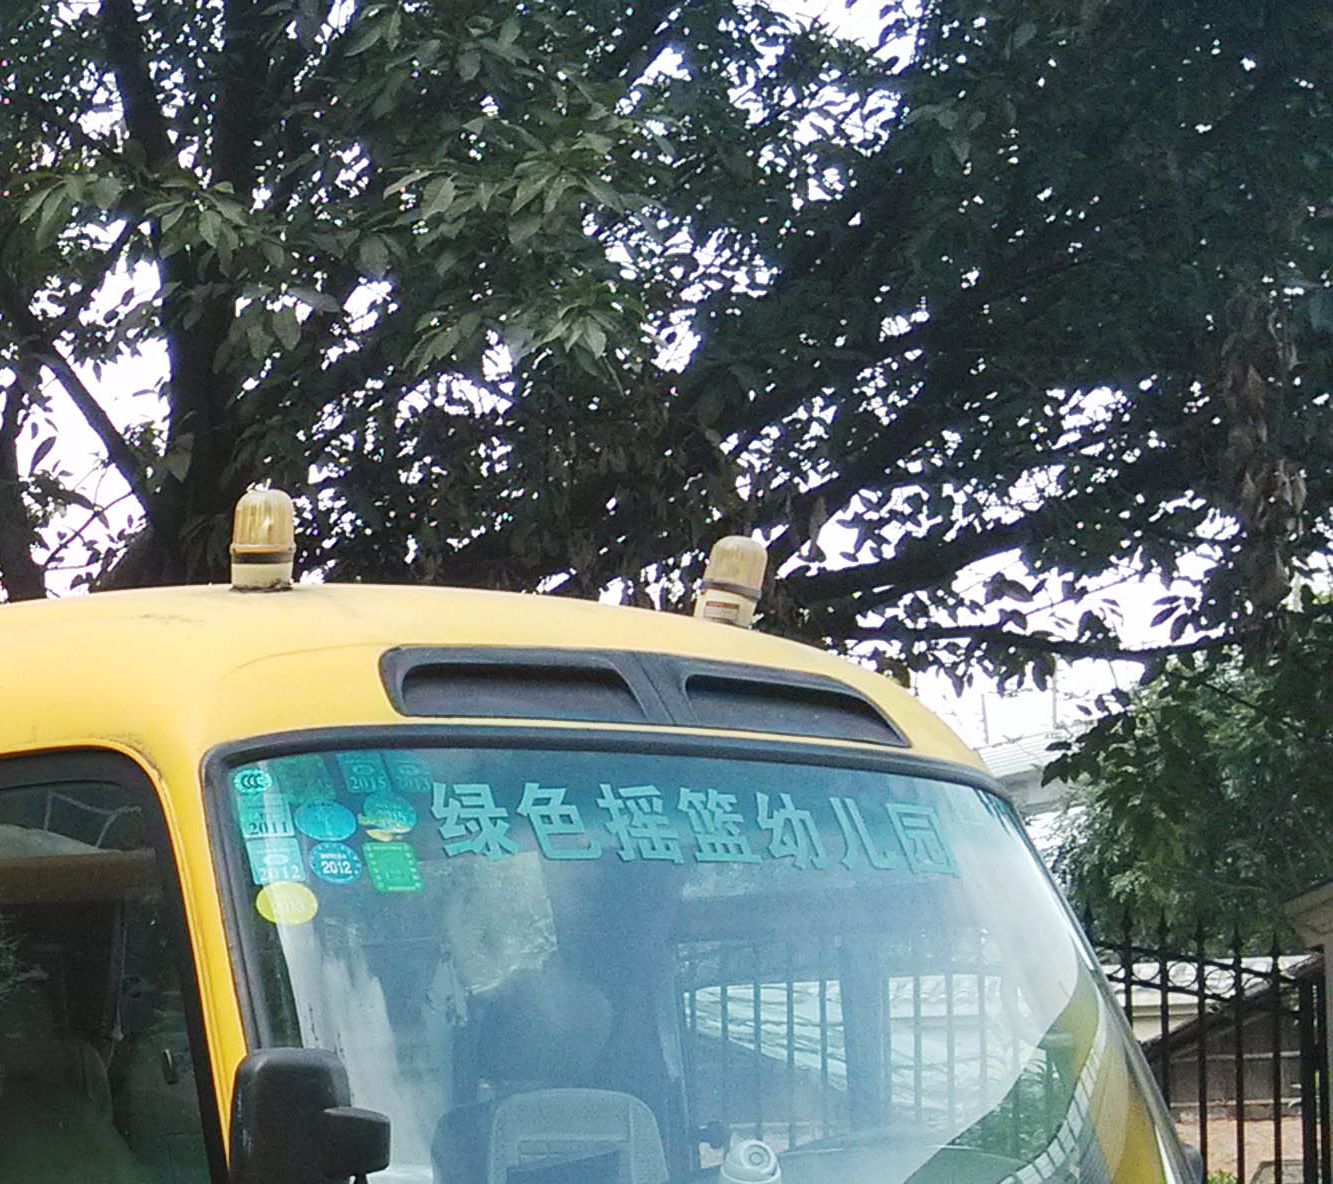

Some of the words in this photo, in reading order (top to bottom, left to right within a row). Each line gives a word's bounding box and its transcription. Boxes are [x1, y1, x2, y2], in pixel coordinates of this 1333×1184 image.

[431, 782, 958, 878] 绿色摇篮幼儿园
[259, 865, 301, 882] 2012
[321, 860, 353, 875] 2012
